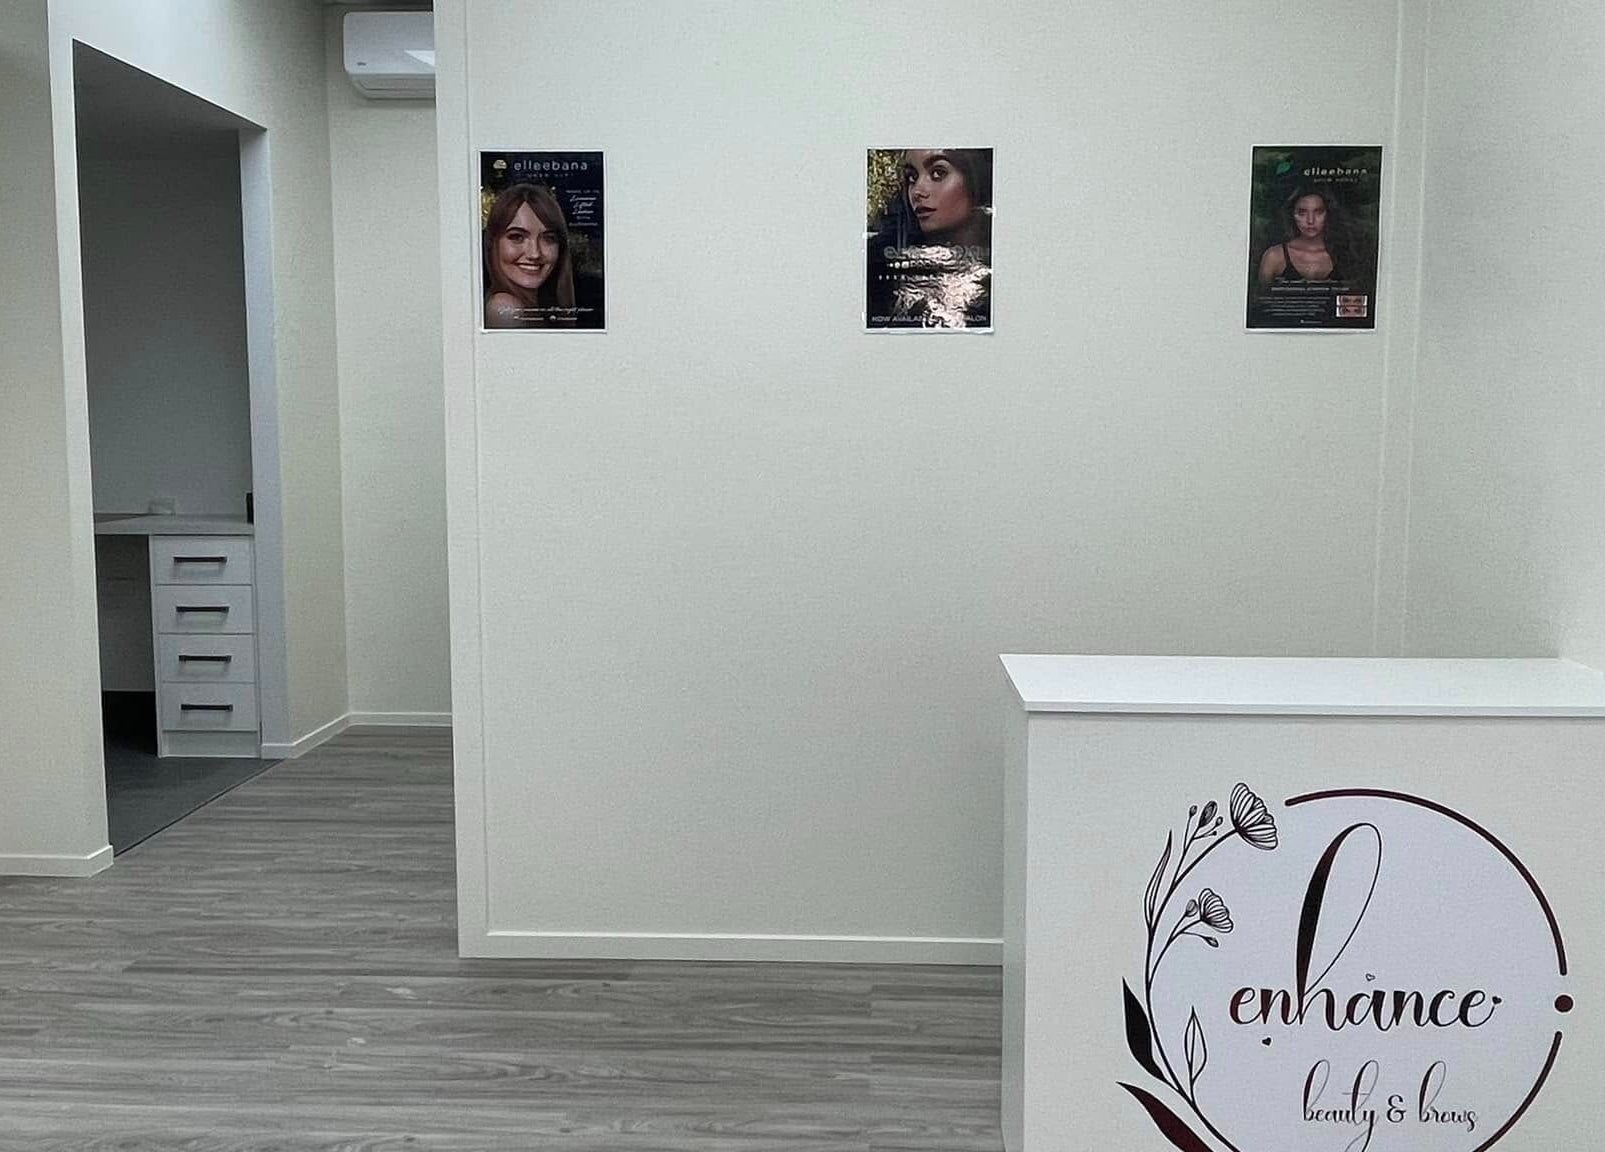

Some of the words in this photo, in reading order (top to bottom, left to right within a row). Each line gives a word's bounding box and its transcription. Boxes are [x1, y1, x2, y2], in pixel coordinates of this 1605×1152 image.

[513, 159, 588, 171] elleebana
[1229, 822, 1496, 1032] enhance
[1303, 1059, 1380, 1152] beauty
[1386, 1094, 1407, 1123] &
[1419, 1060, 1478, 1132] brows
